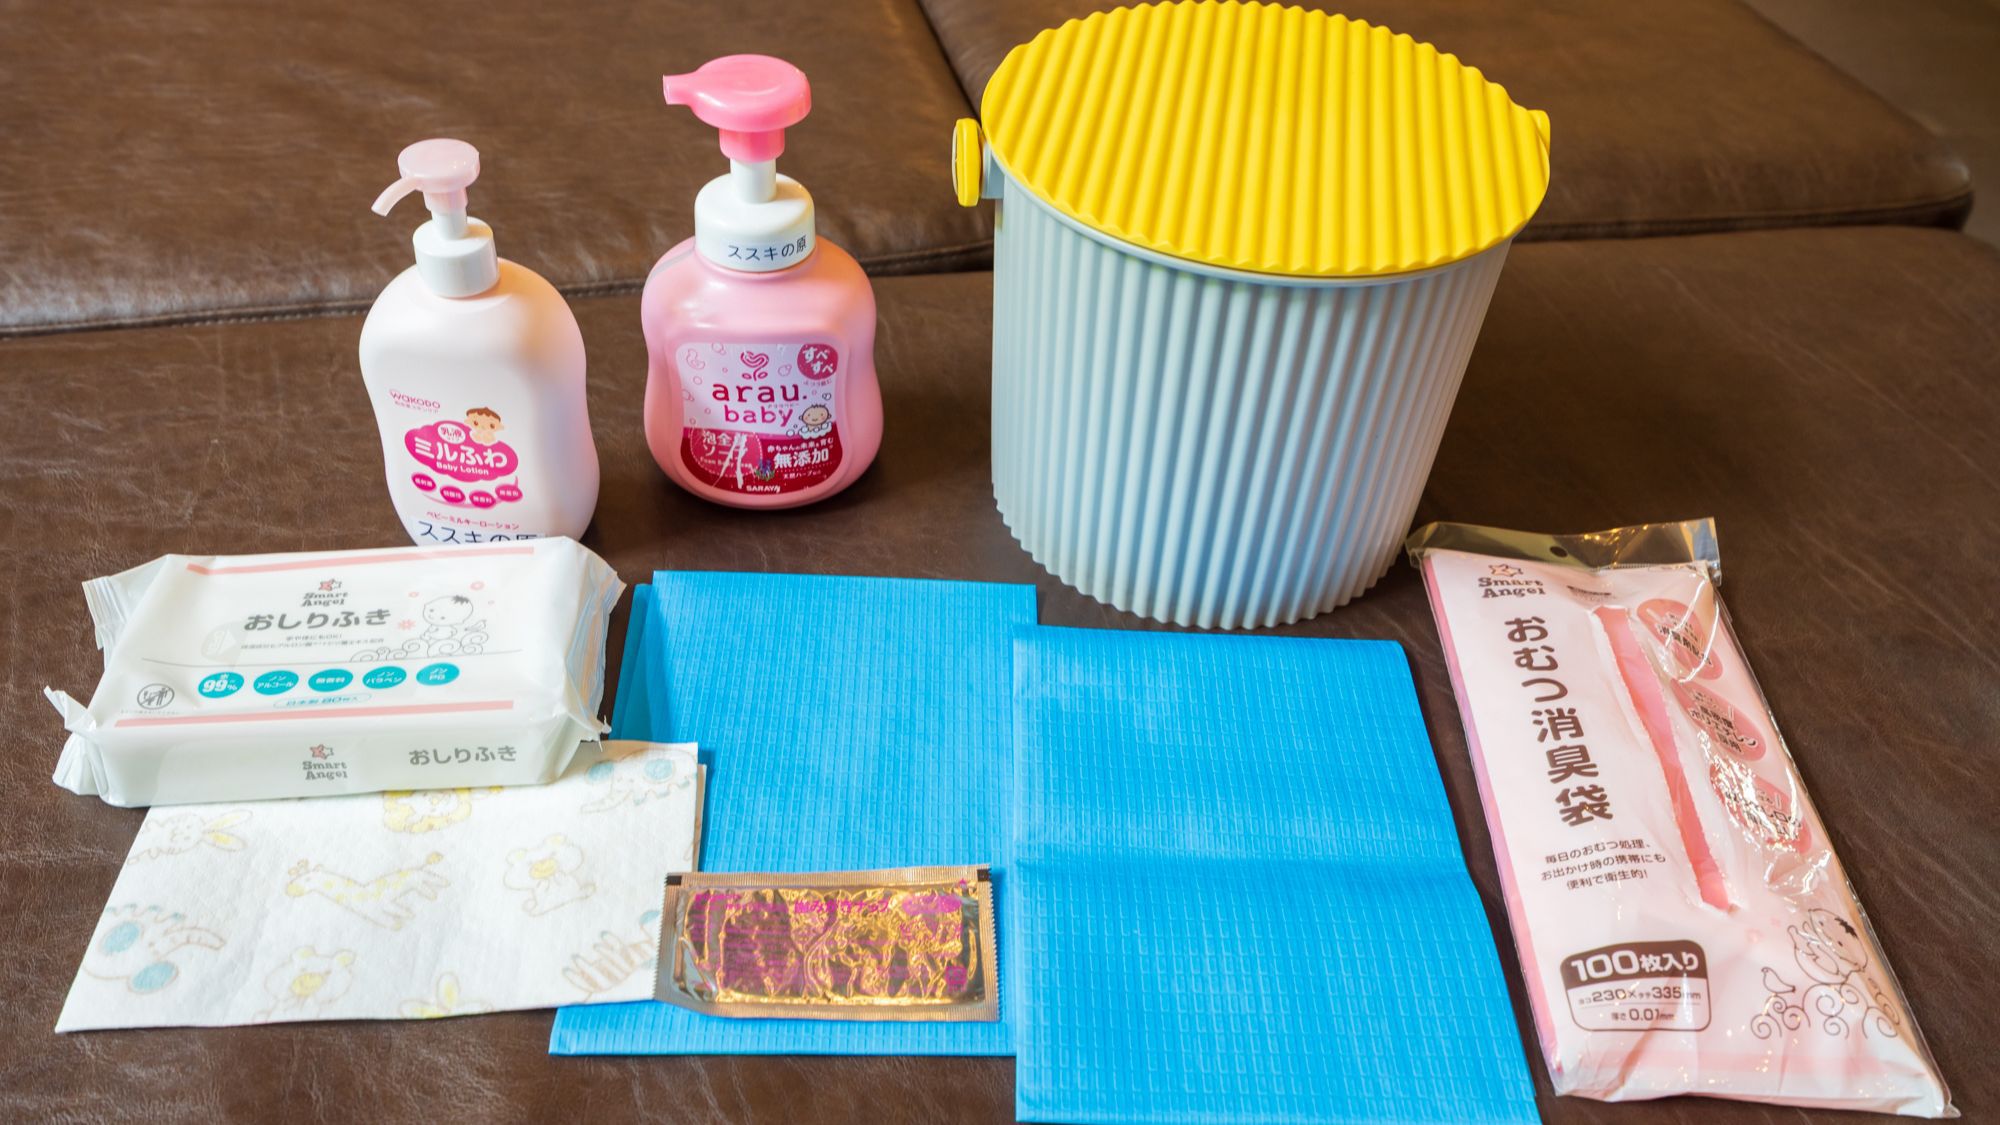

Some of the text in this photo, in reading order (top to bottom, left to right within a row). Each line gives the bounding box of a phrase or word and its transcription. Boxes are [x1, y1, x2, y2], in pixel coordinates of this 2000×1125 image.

[728, 234, 807, 261] ススキの原
[802, 346, 830, 363] すべ
[811, 360, 833, 375] すべ
[724, 405, 793, 427] baby
[415, 437, 507, 467] ミルふわ
[773, 448, 829, 469] 無添加
[436, 462, 489, 476] Baby Lotion
[1478, 577, 1544, 587] Smart
[303, 591, 348, 600] Smart
[1482, 587, 1546, 598] Angel
[301, 598, 345, 607] Angel
[244, 608, 391, 631] おしりふき
[1504, 616, 1614, 827] おむつ消臭袋
[409, 746, 517, 765] おしりふき
[302, 761, 348, 770] Smart
[305, 770, 348, 781] Angel
[1541, 854, 1666, 881] お出かけ時の携帯にも
[1571, 950, 1699, 982] 100枚入り
